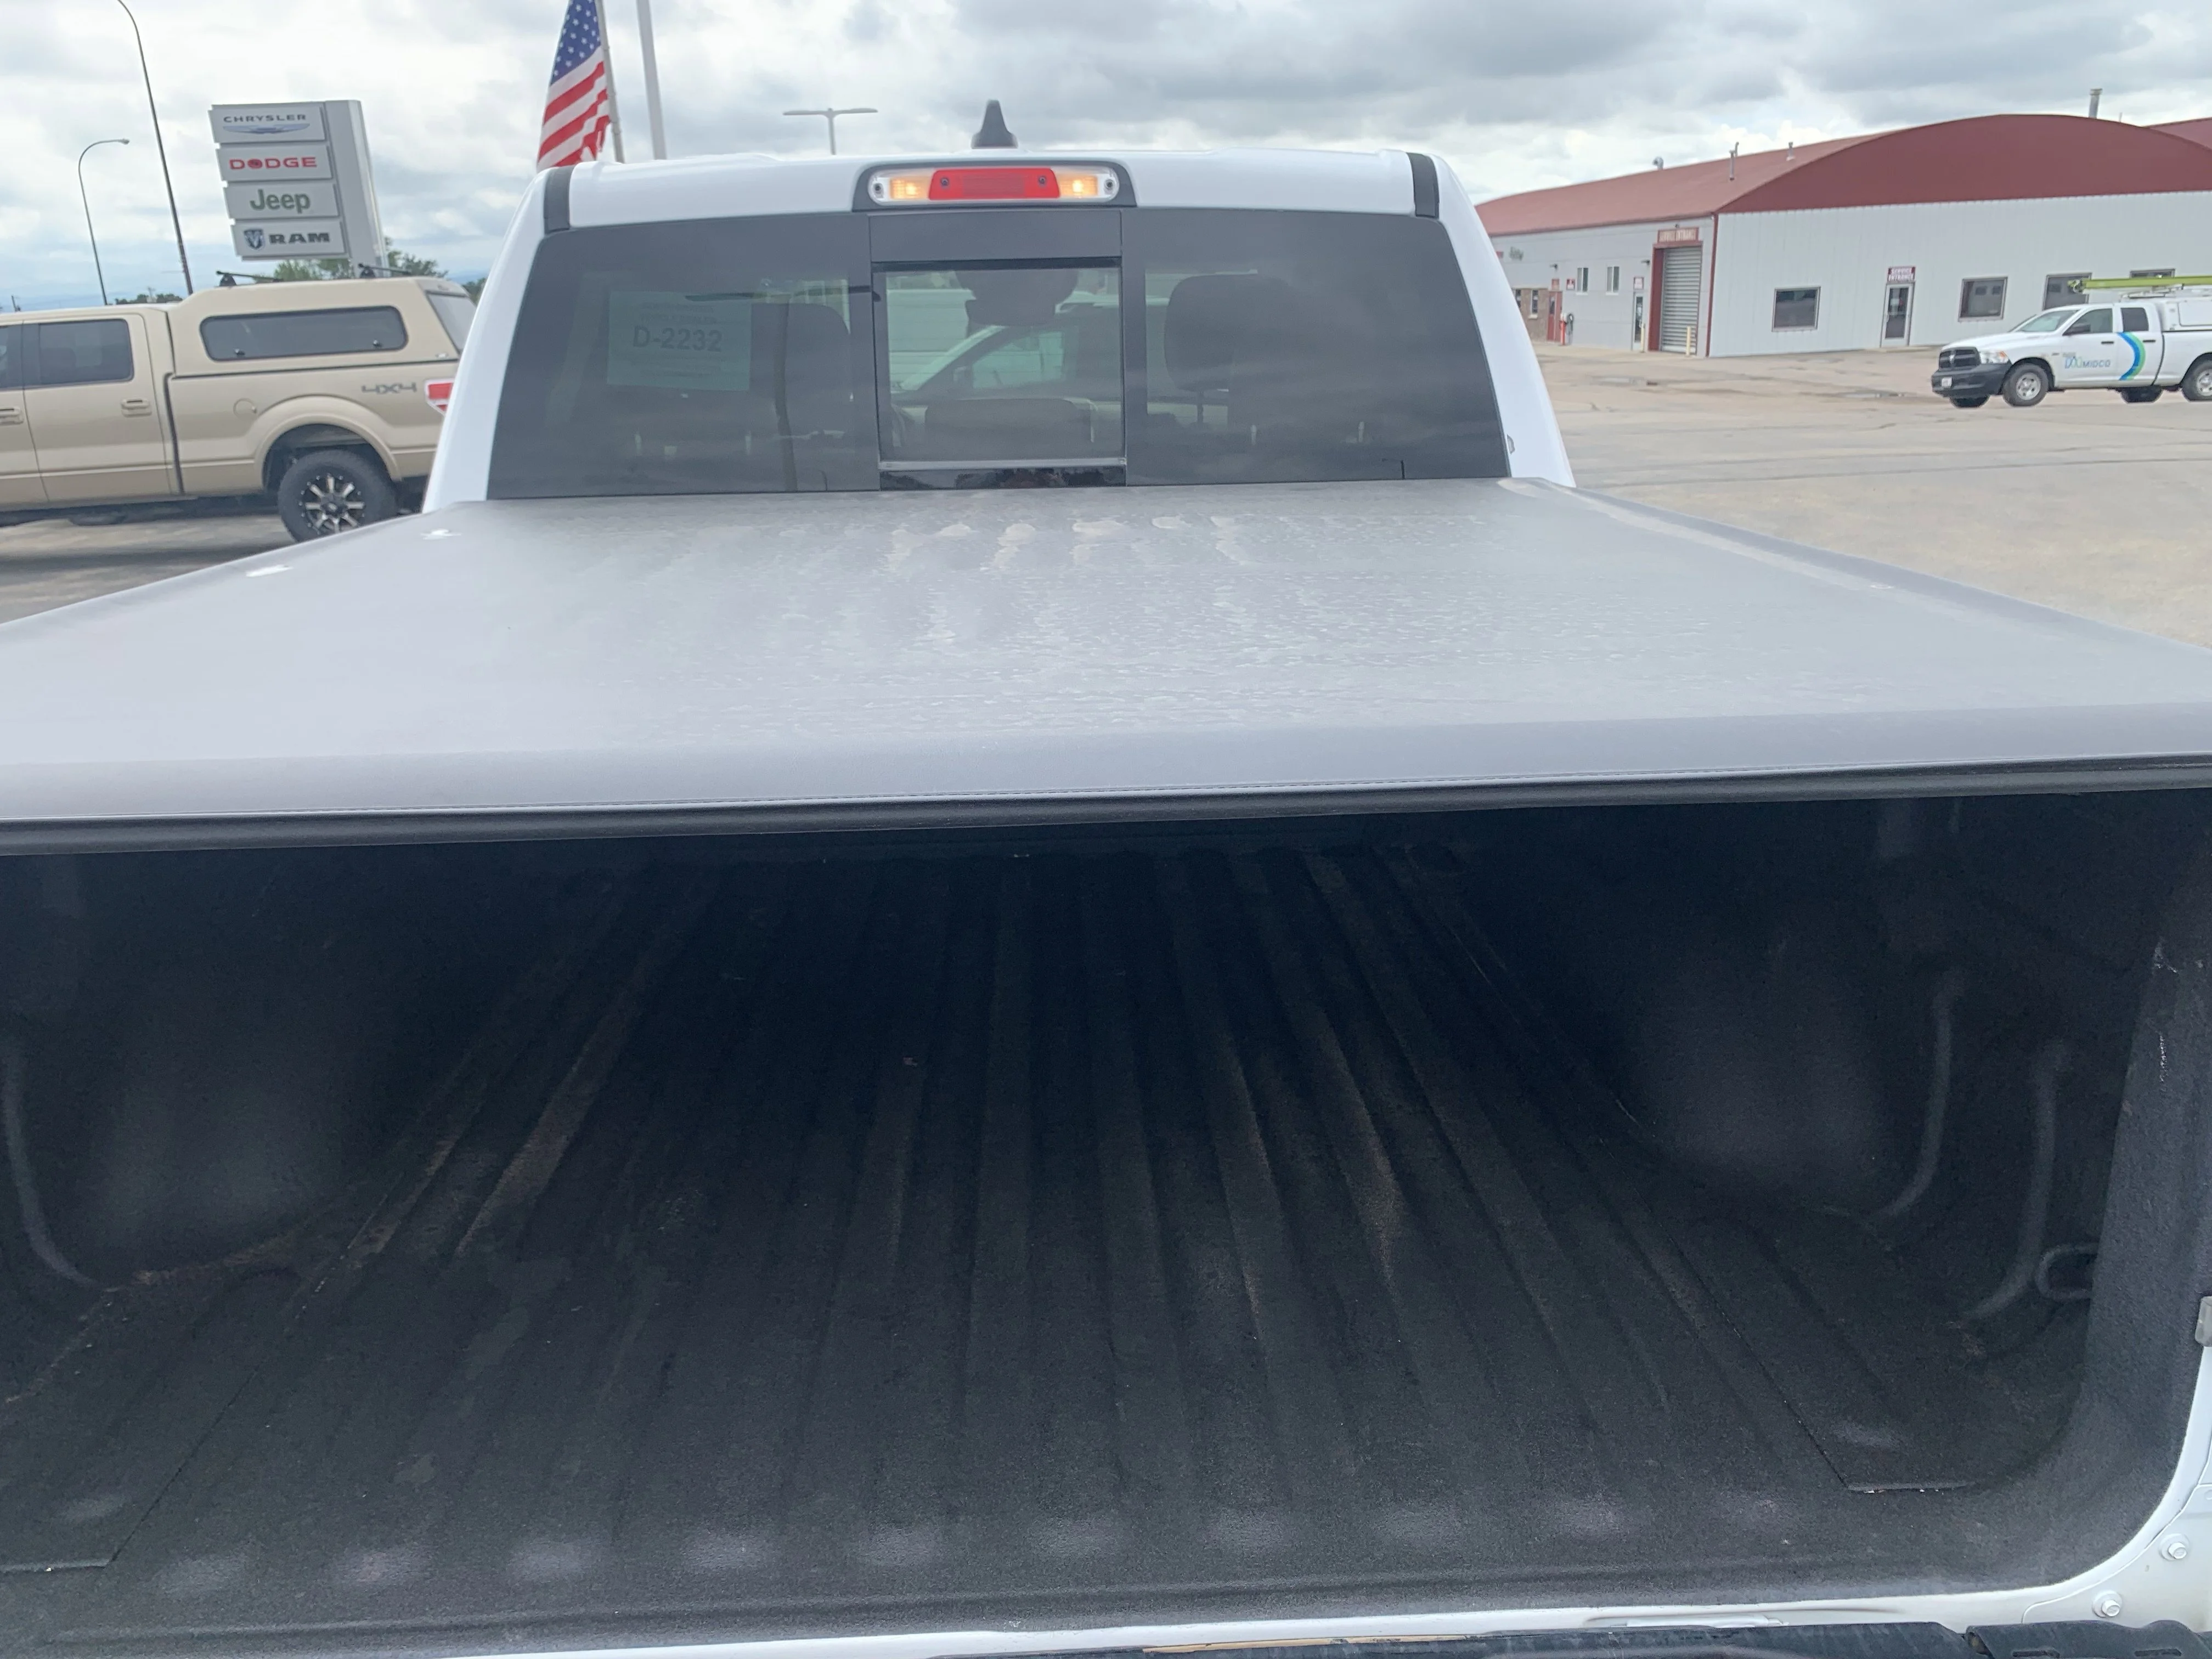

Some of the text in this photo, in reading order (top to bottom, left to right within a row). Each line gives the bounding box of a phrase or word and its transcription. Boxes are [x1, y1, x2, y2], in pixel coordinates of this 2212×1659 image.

[223, 114, 307, 123] CHRYSLER
[229, 157, 317, 170] DODGE
[250, 189, 311, 213] Jeep
[269, 233, 330, 244] RAM
[633, 325, 723, 352] D-2232
[2083, 360, 2111, 369] MIDCO
